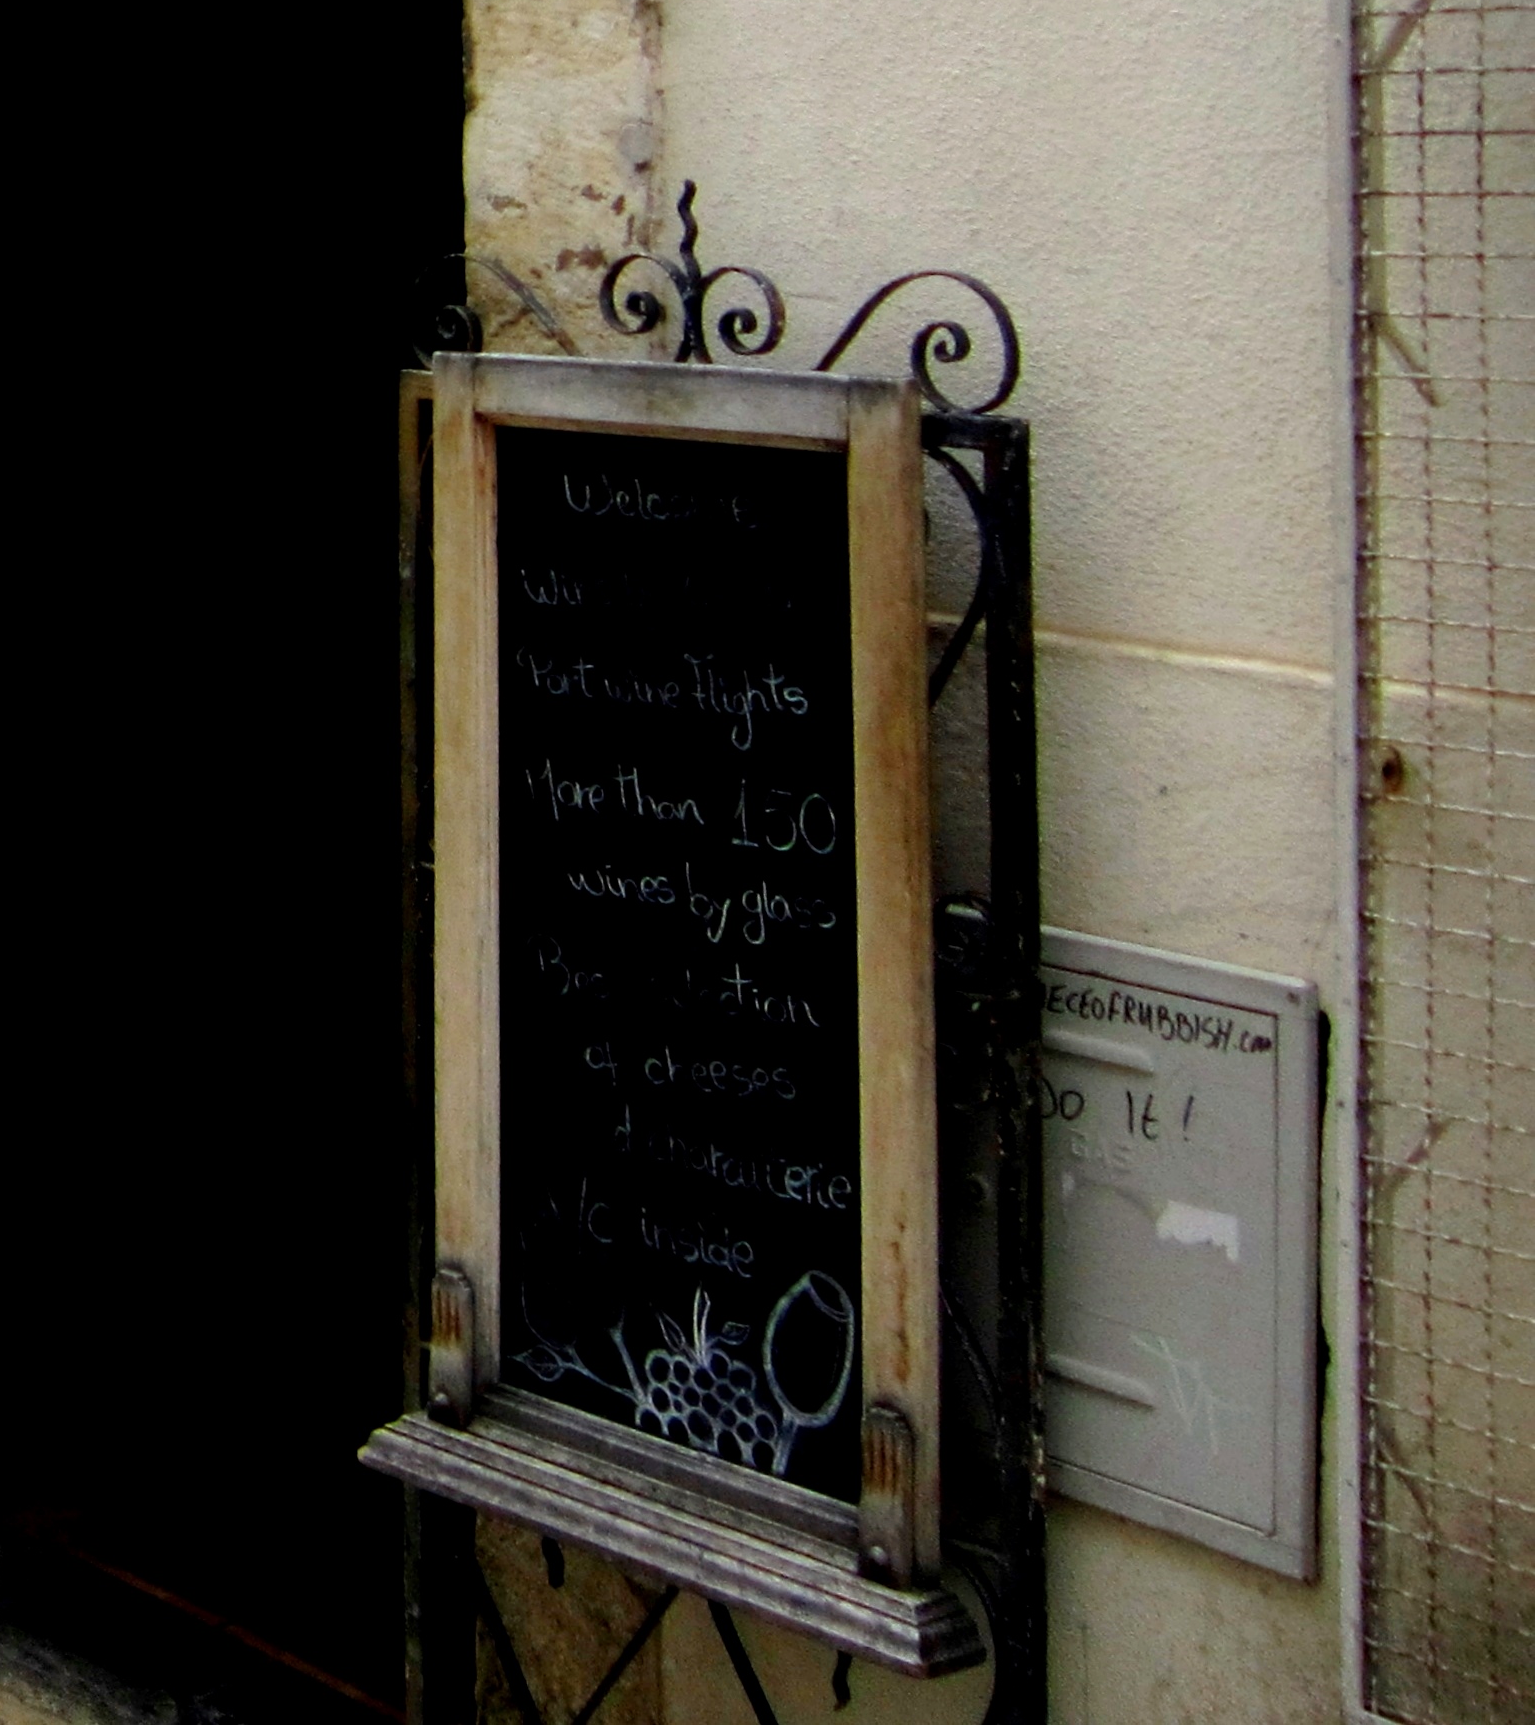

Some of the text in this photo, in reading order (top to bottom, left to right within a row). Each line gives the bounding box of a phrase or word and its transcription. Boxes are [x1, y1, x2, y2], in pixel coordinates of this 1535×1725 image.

[563, 473, 759, 528] Welcoe
[525, 758, 837, 855] More than 150
[567, 861, 838, 945] wines by glass
[643, 1044, 798, 1101] cheeses
